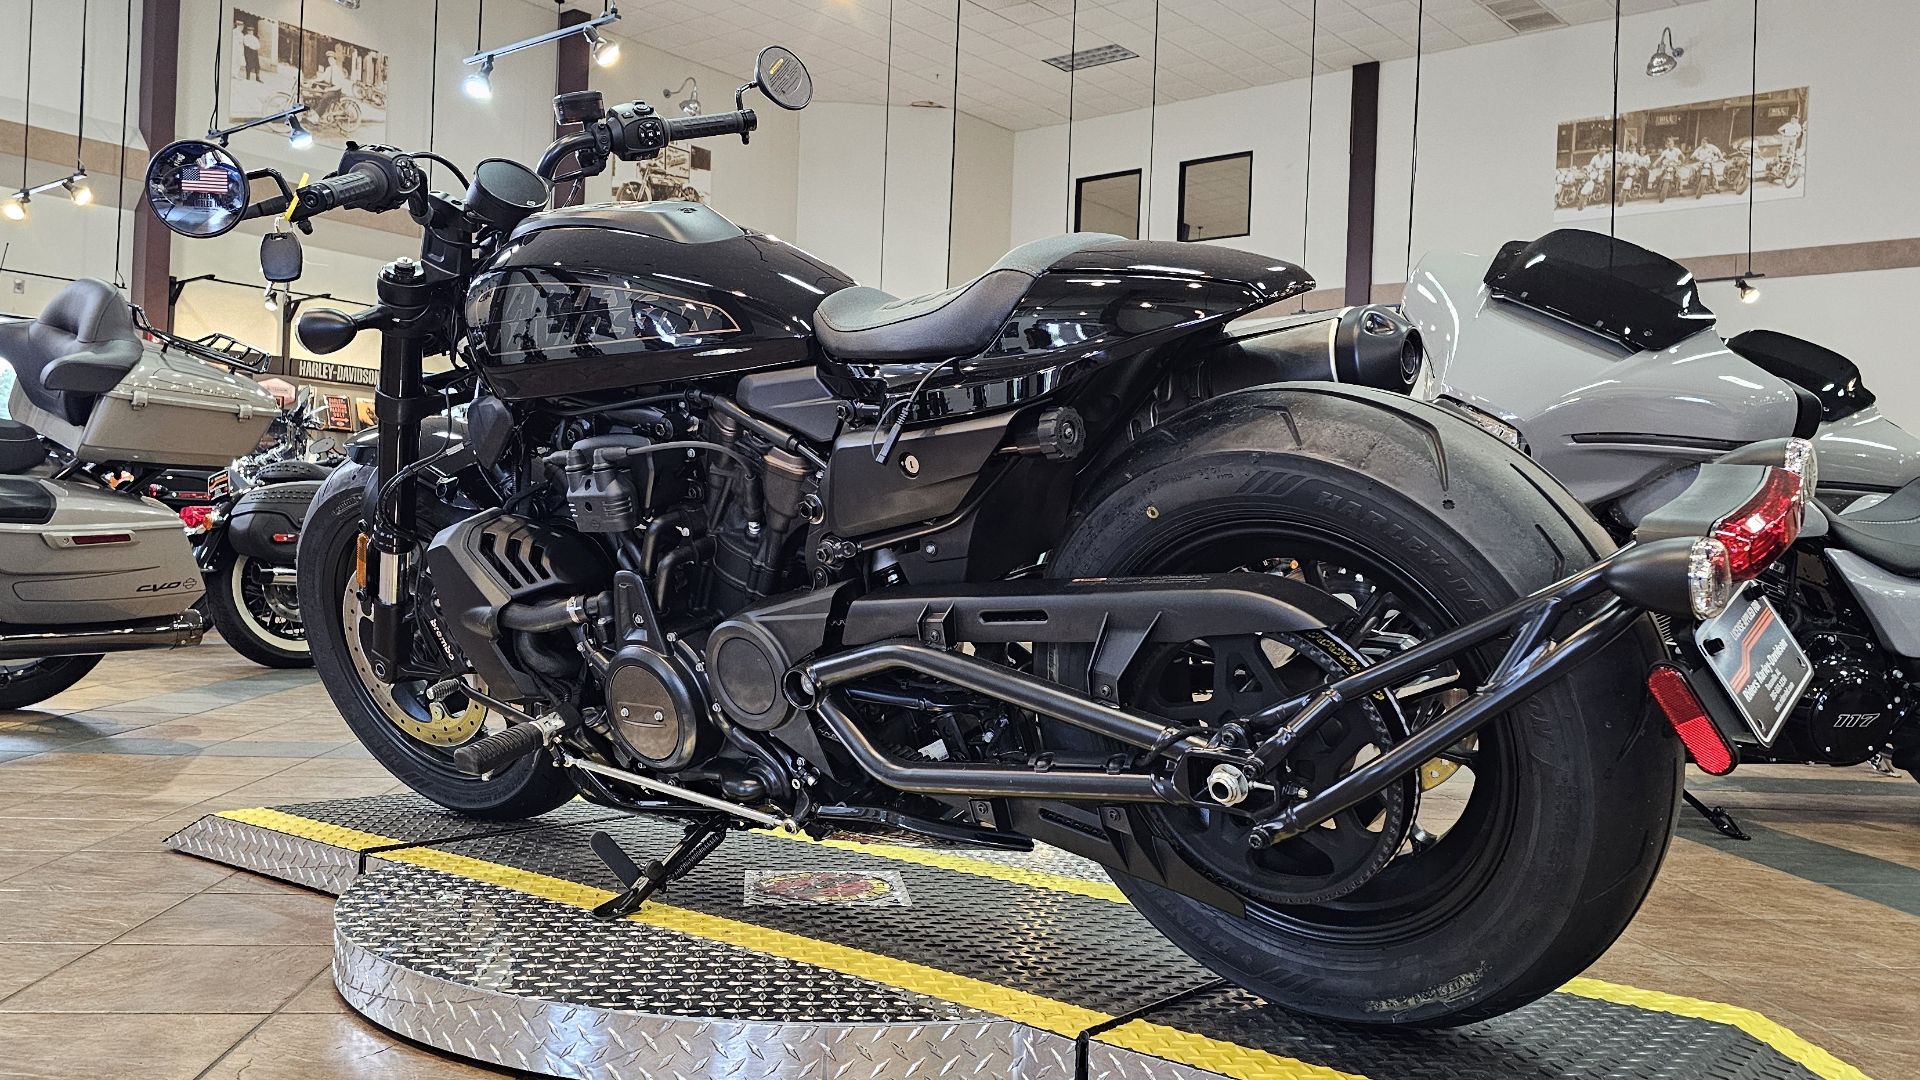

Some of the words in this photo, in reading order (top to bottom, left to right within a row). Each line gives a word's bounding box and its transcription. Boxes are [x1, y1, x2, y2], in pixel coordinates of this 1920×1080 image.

[299, 360, 380, 385] HARLEY-DAVIDSON
[136, 581, 182, 592] CVO
[429, 618, 455, 661] brembo
[1742, 677, 1760, 703] Riders
[1754, 638, 1789, 686] Harley-Davidson
[1833, 713, 1880, 728] 117
